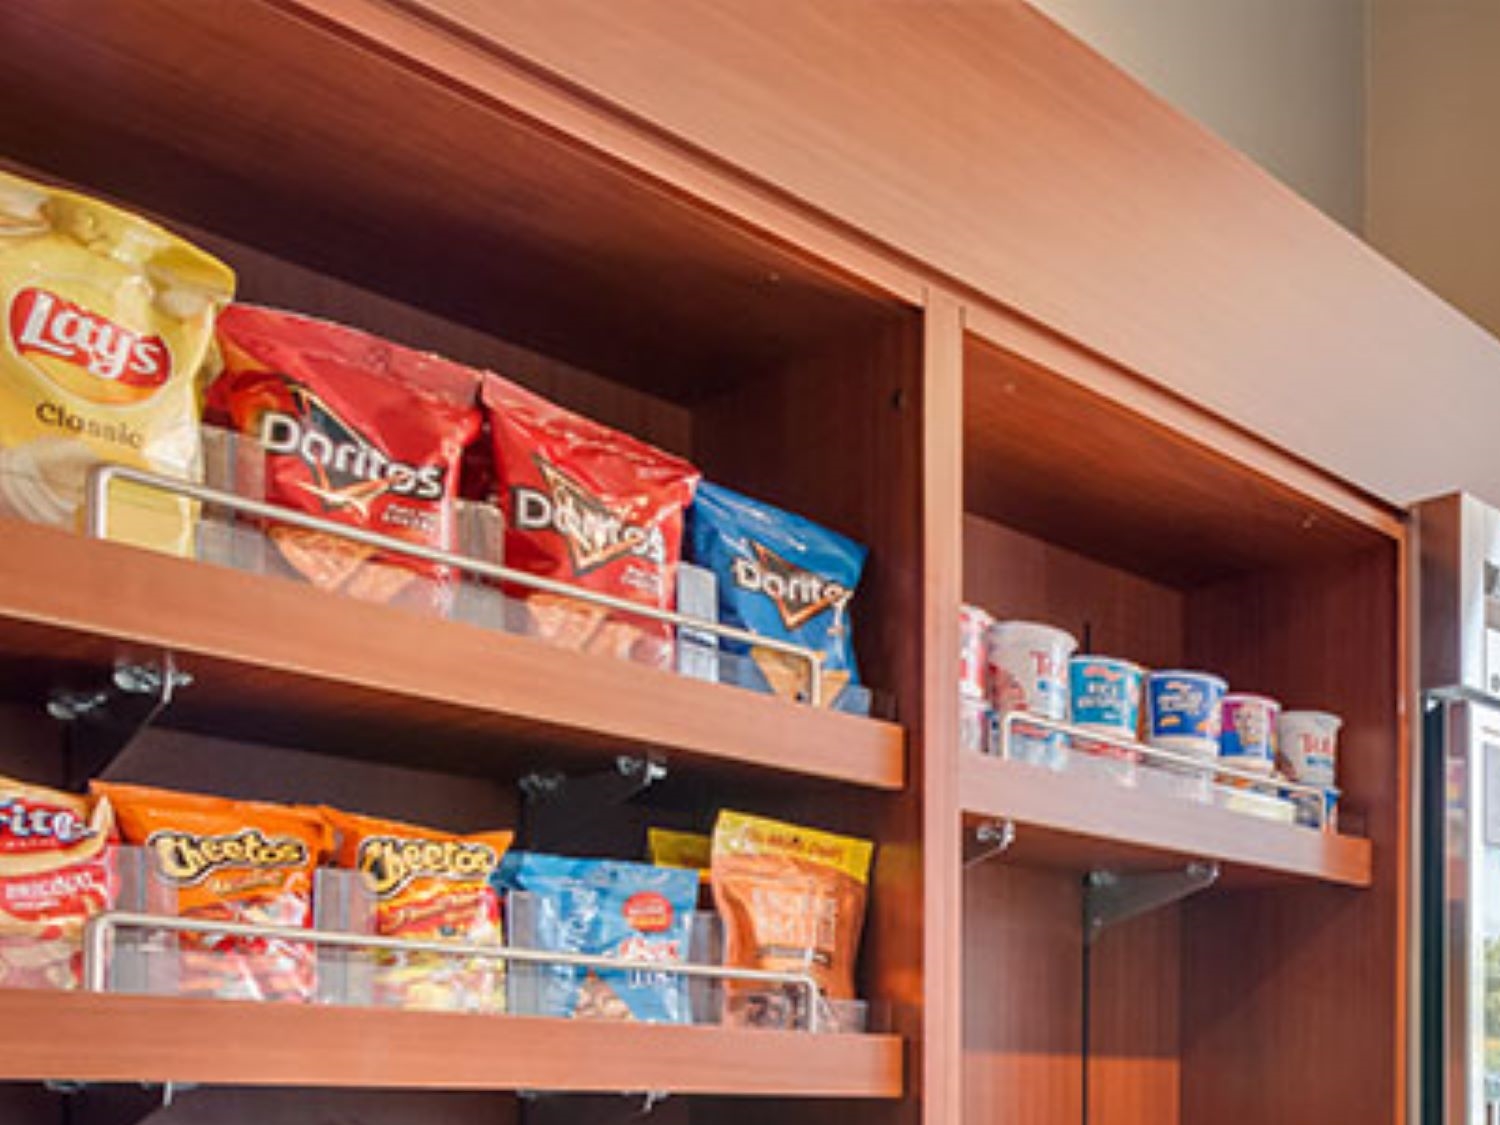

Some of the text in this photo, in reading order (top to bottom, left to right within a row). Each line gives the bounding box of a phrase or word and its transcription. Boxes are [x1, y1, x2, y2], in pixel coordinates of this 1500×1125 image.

[35, 401, 142, 449] Classic
[262, 412, 442, 497] Doritos
[155, 834, 302, 878] Cheetos
[360, 840, 492, 894] Cheetos
